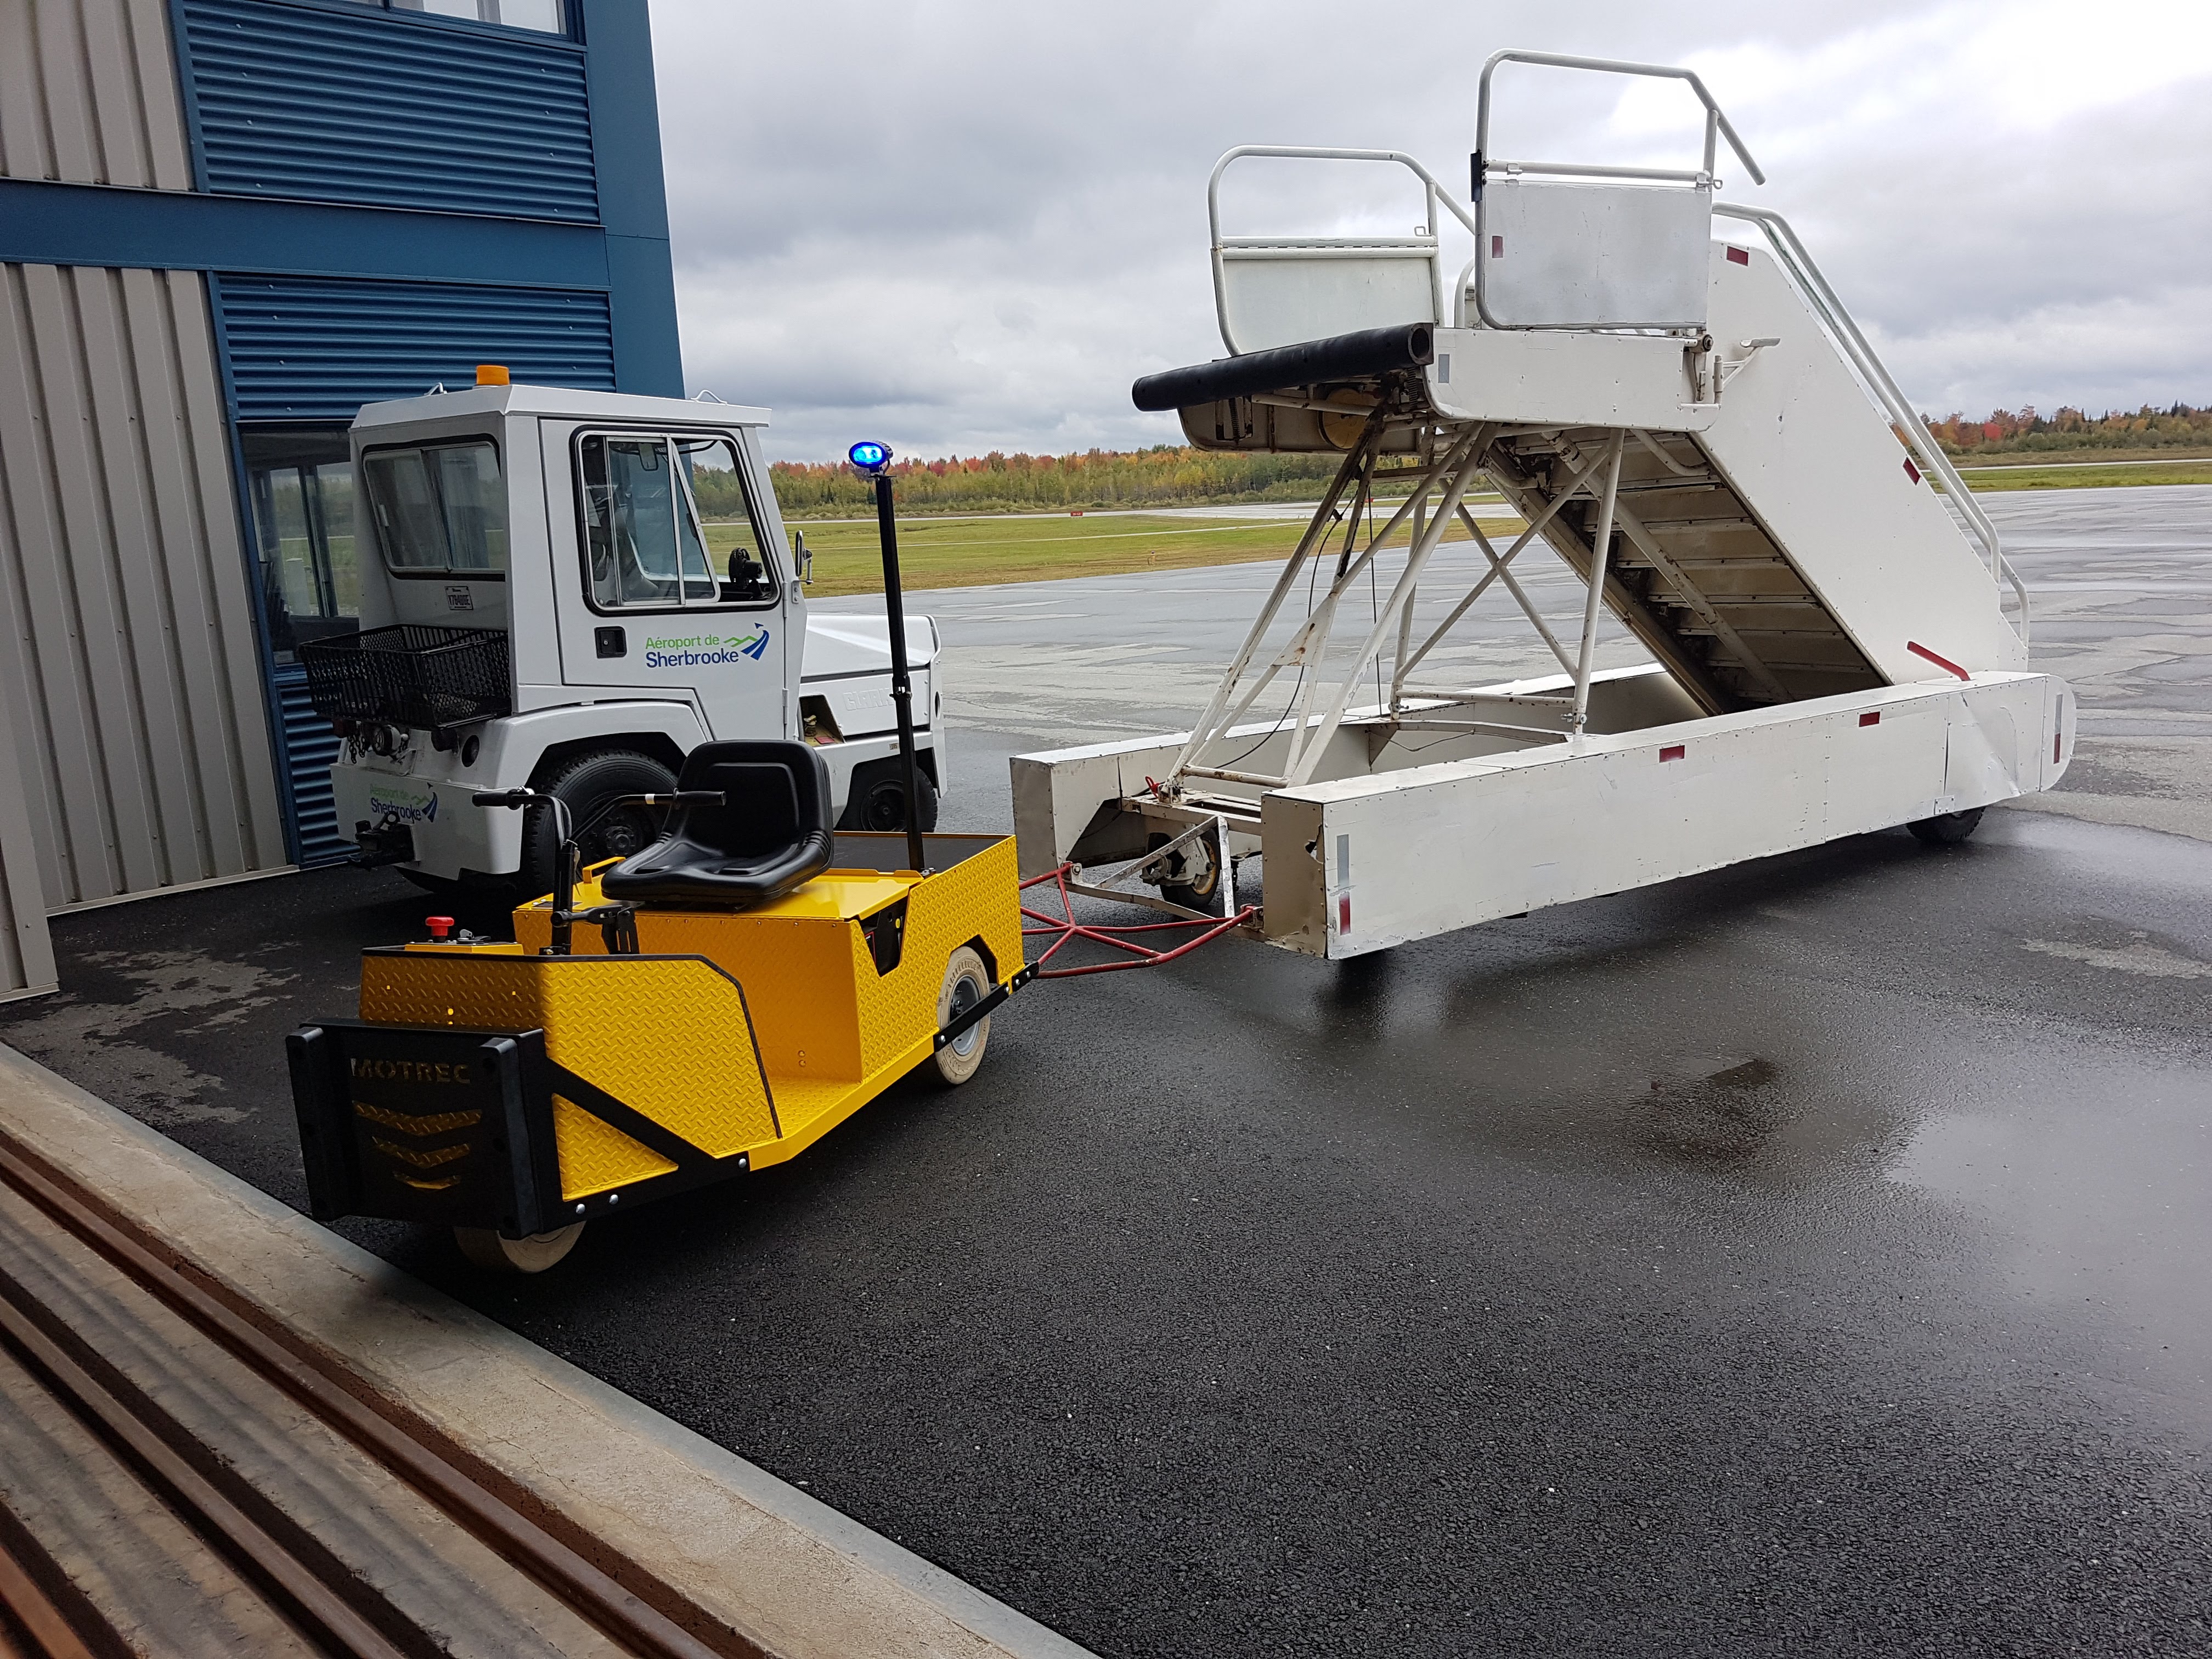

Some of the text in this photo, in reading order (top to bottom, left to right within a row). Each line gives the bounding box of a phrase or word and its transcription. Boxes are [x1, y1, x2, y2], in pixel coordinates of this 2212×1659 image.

[646, 634, 720, 650] Aéroport de
[646, 648, 739, 668] Sherbrooke
[350, 1058, 471, 1084] MOTREC
